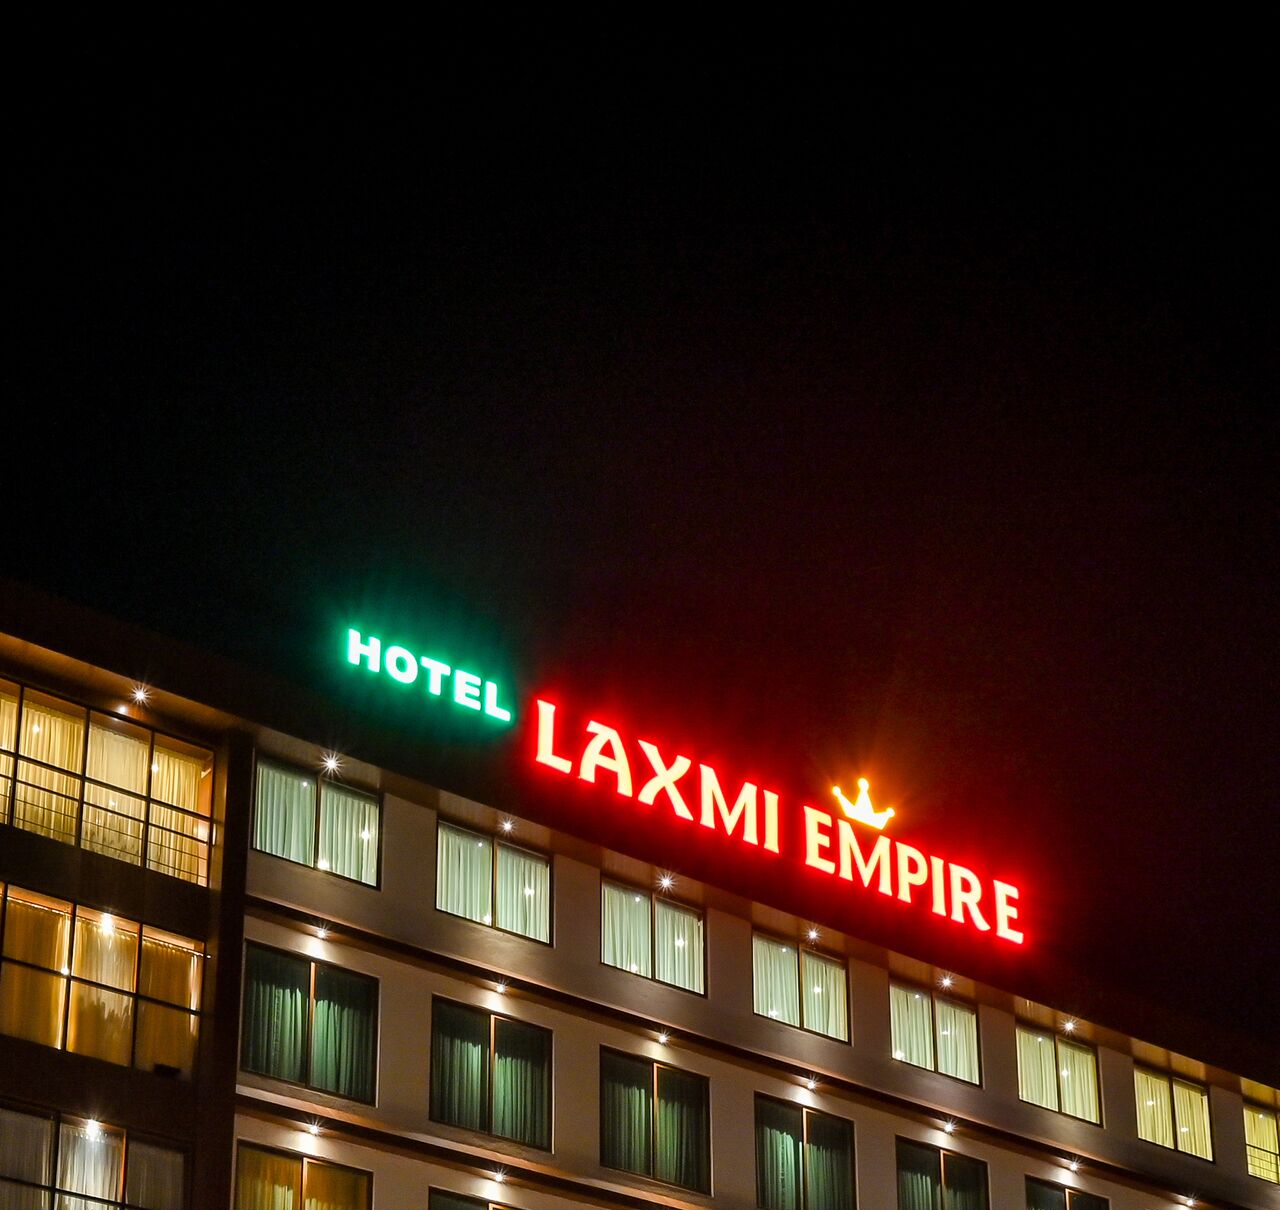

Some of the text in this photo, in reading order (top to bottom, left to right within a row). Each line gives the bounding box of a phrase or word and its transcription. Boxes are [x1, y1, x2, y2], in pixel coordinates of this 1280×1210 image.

[346, 629, 513, 723] HOTEL
[534, 698, 1024, 946] LAXMI EMPIRE
